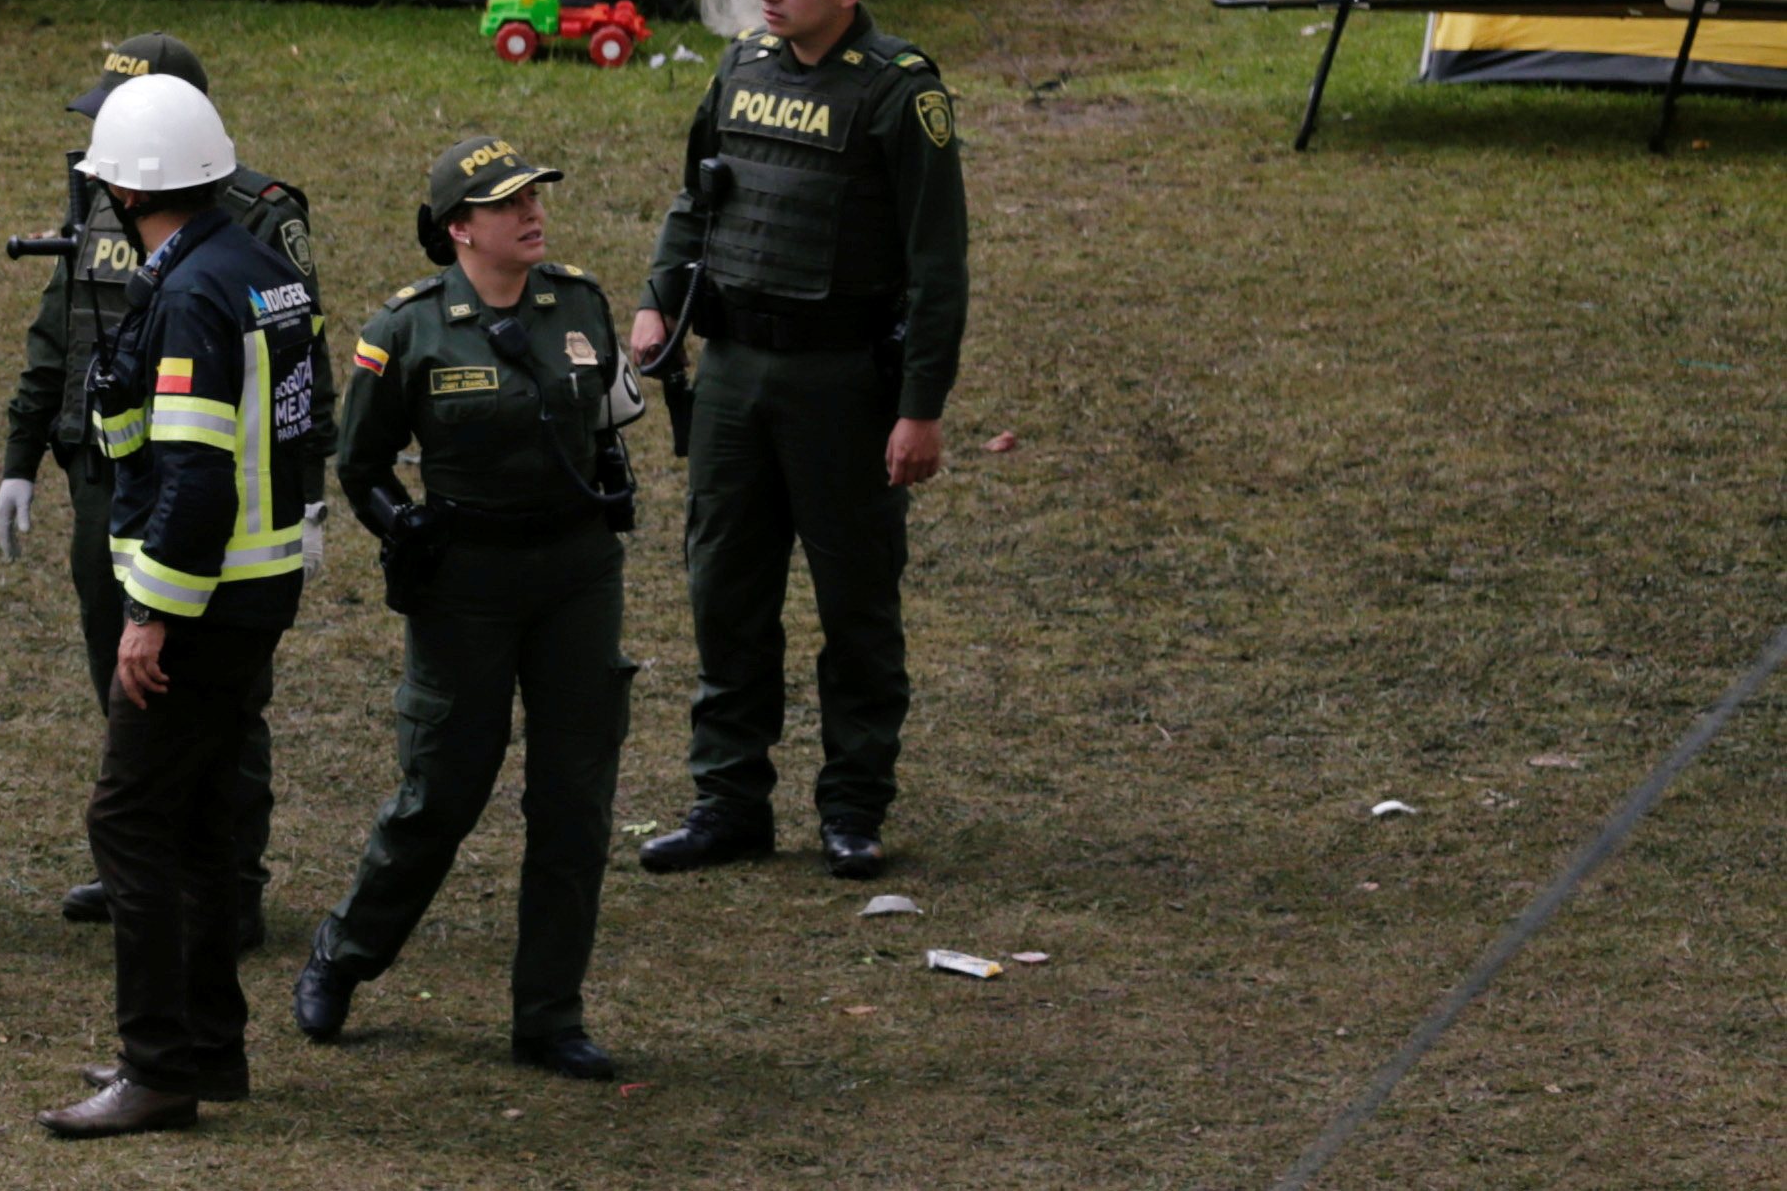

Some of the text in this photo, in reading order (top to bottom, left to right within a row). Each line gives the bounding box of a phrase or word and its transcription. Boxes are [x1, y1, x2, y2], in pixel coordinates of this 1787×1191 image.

[730, 89, 830, 137] POLICIA
[261, 282, 312, 313] IDIGER
[275, 389, 312, 427] MEJOR
[277, 423, 300, 443] PARA
